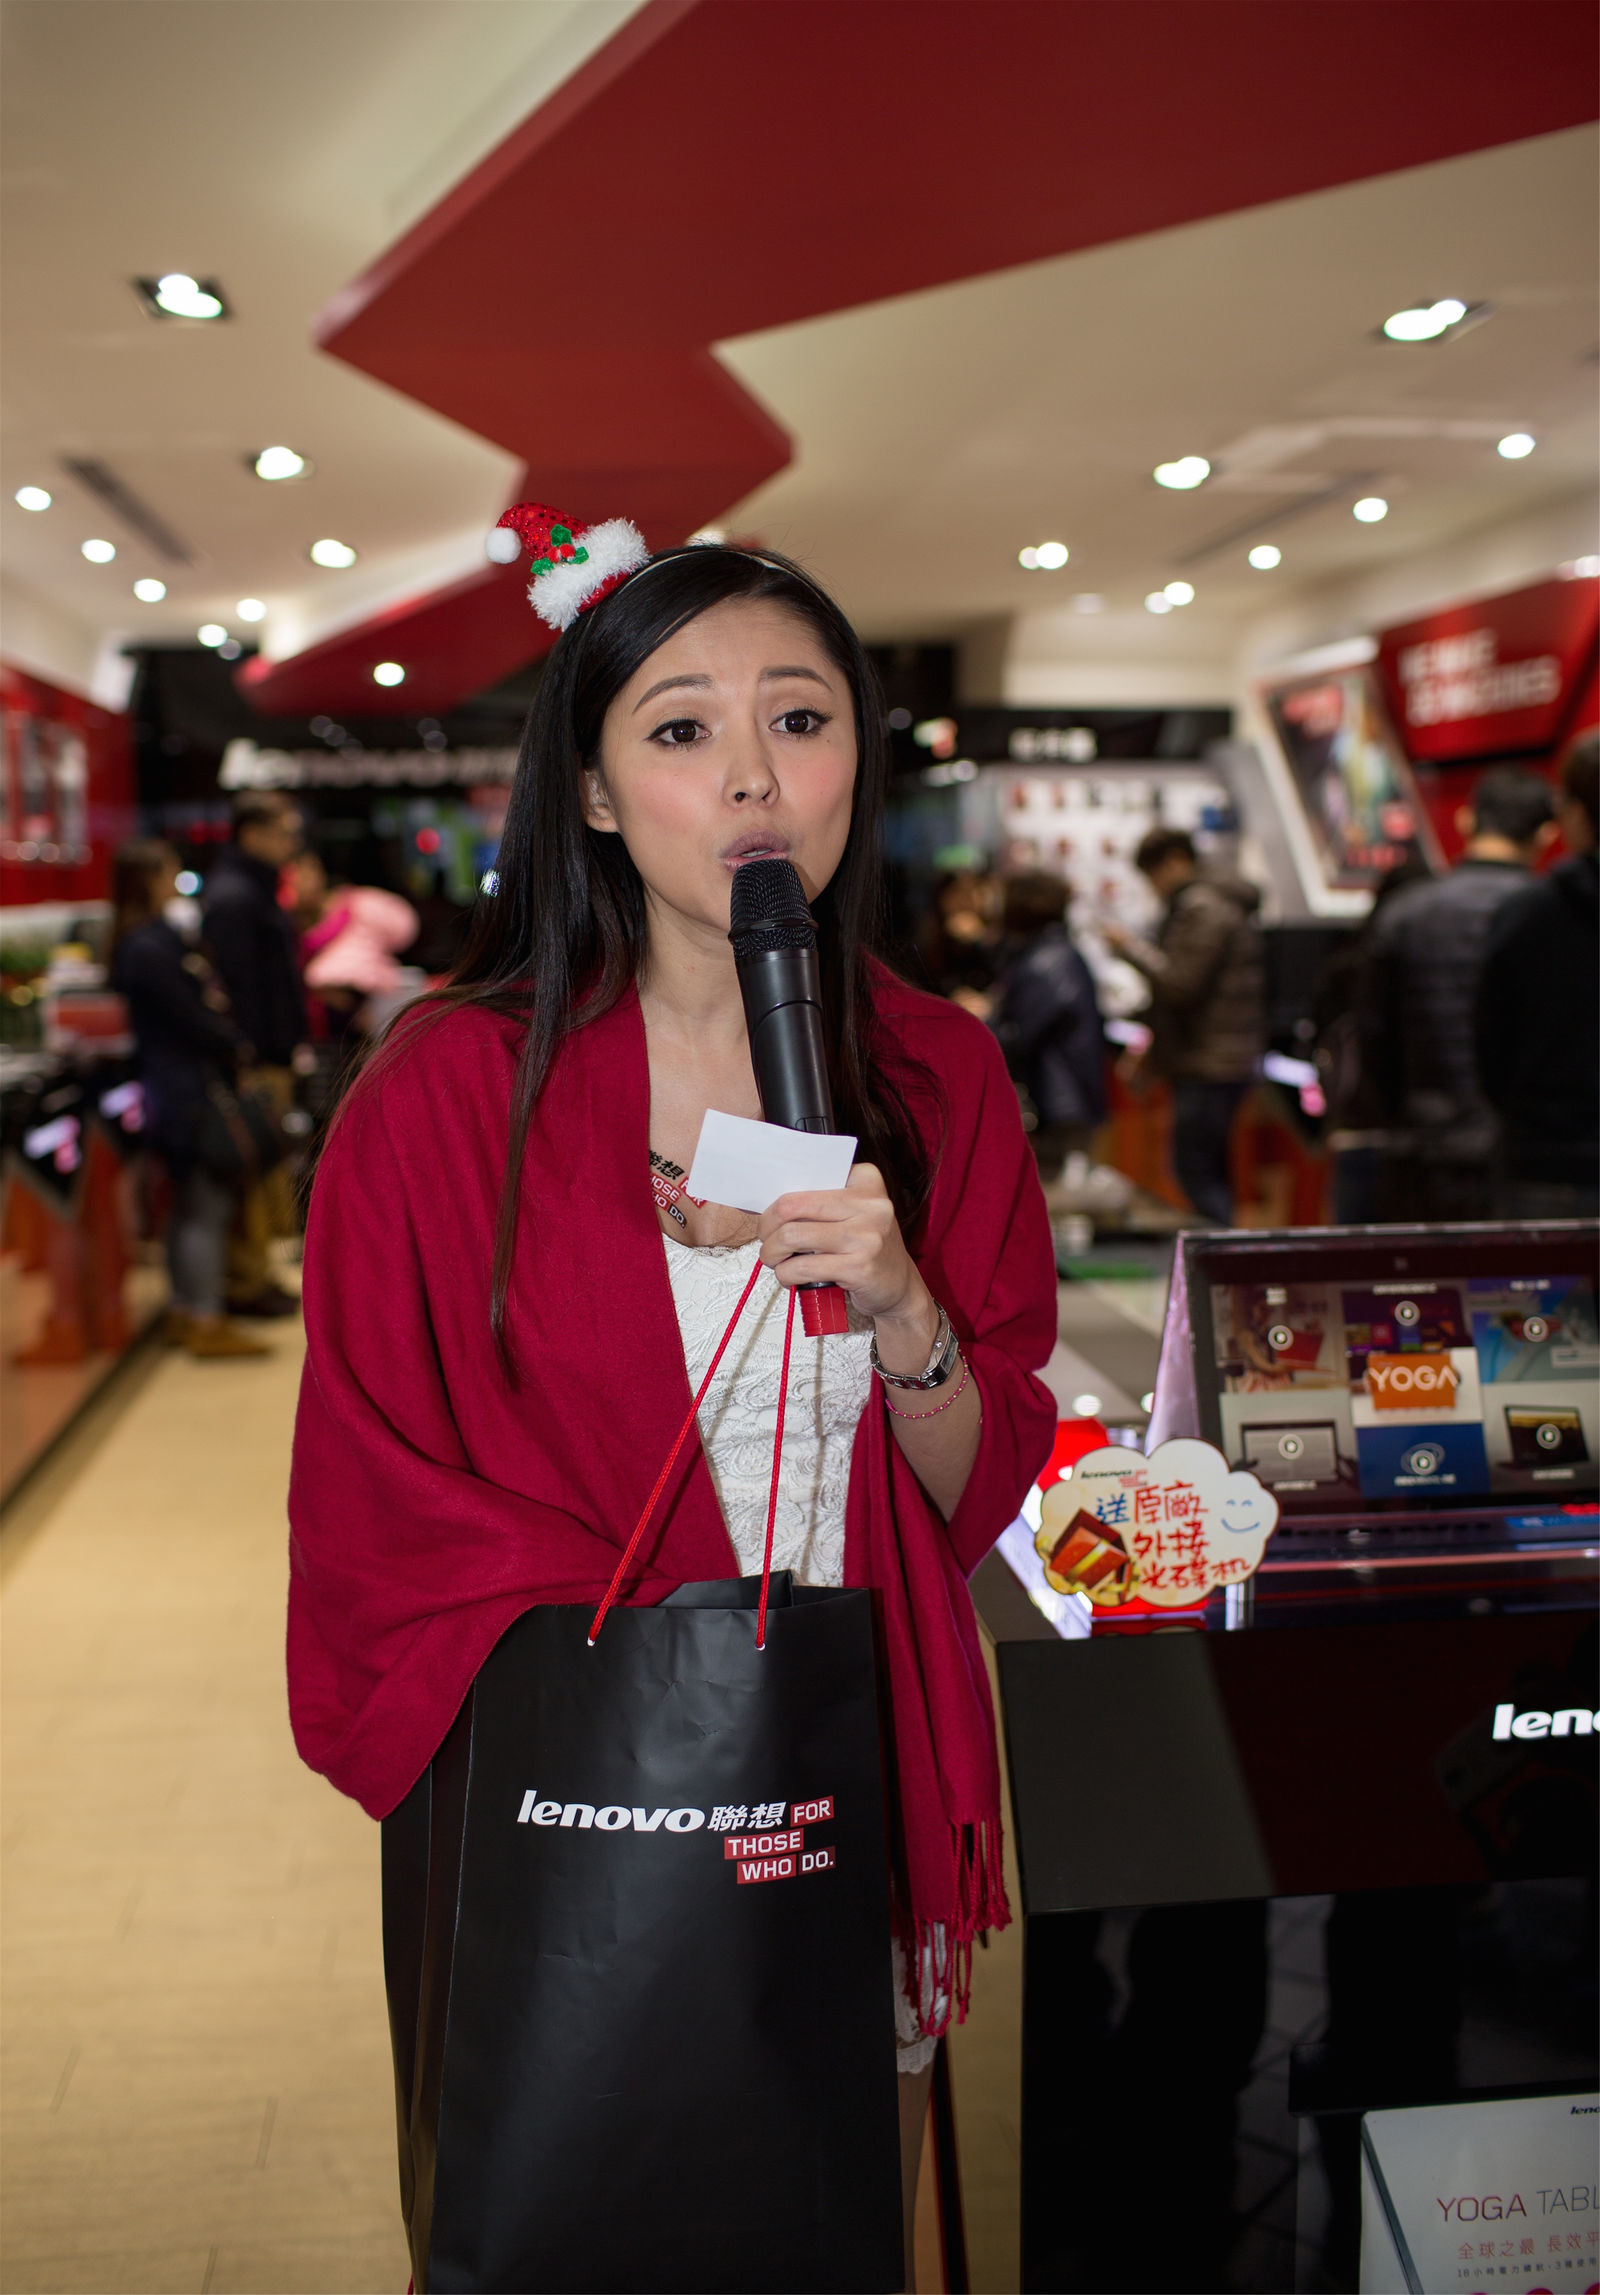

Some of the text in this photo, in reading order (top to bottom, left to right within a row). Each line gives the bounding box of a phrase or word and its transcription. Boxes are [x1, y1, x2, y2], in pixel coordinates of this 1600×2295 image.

[669, 1205, 686, 1228] DO.
[1368, 1365, 1458, 1393] YOGA
[1492, 1703, 1598, 1740] len
[517, 1789, 831, 1833] lenovo 聯想 FOR
[727, 1832, 802, 1856] THOSE
[741, 1849, 835, 1881] WHO DO.
[1436, 2194, 1528, 2223] YOGA
[1457, 2238, 1536, 2261] 全球之最
